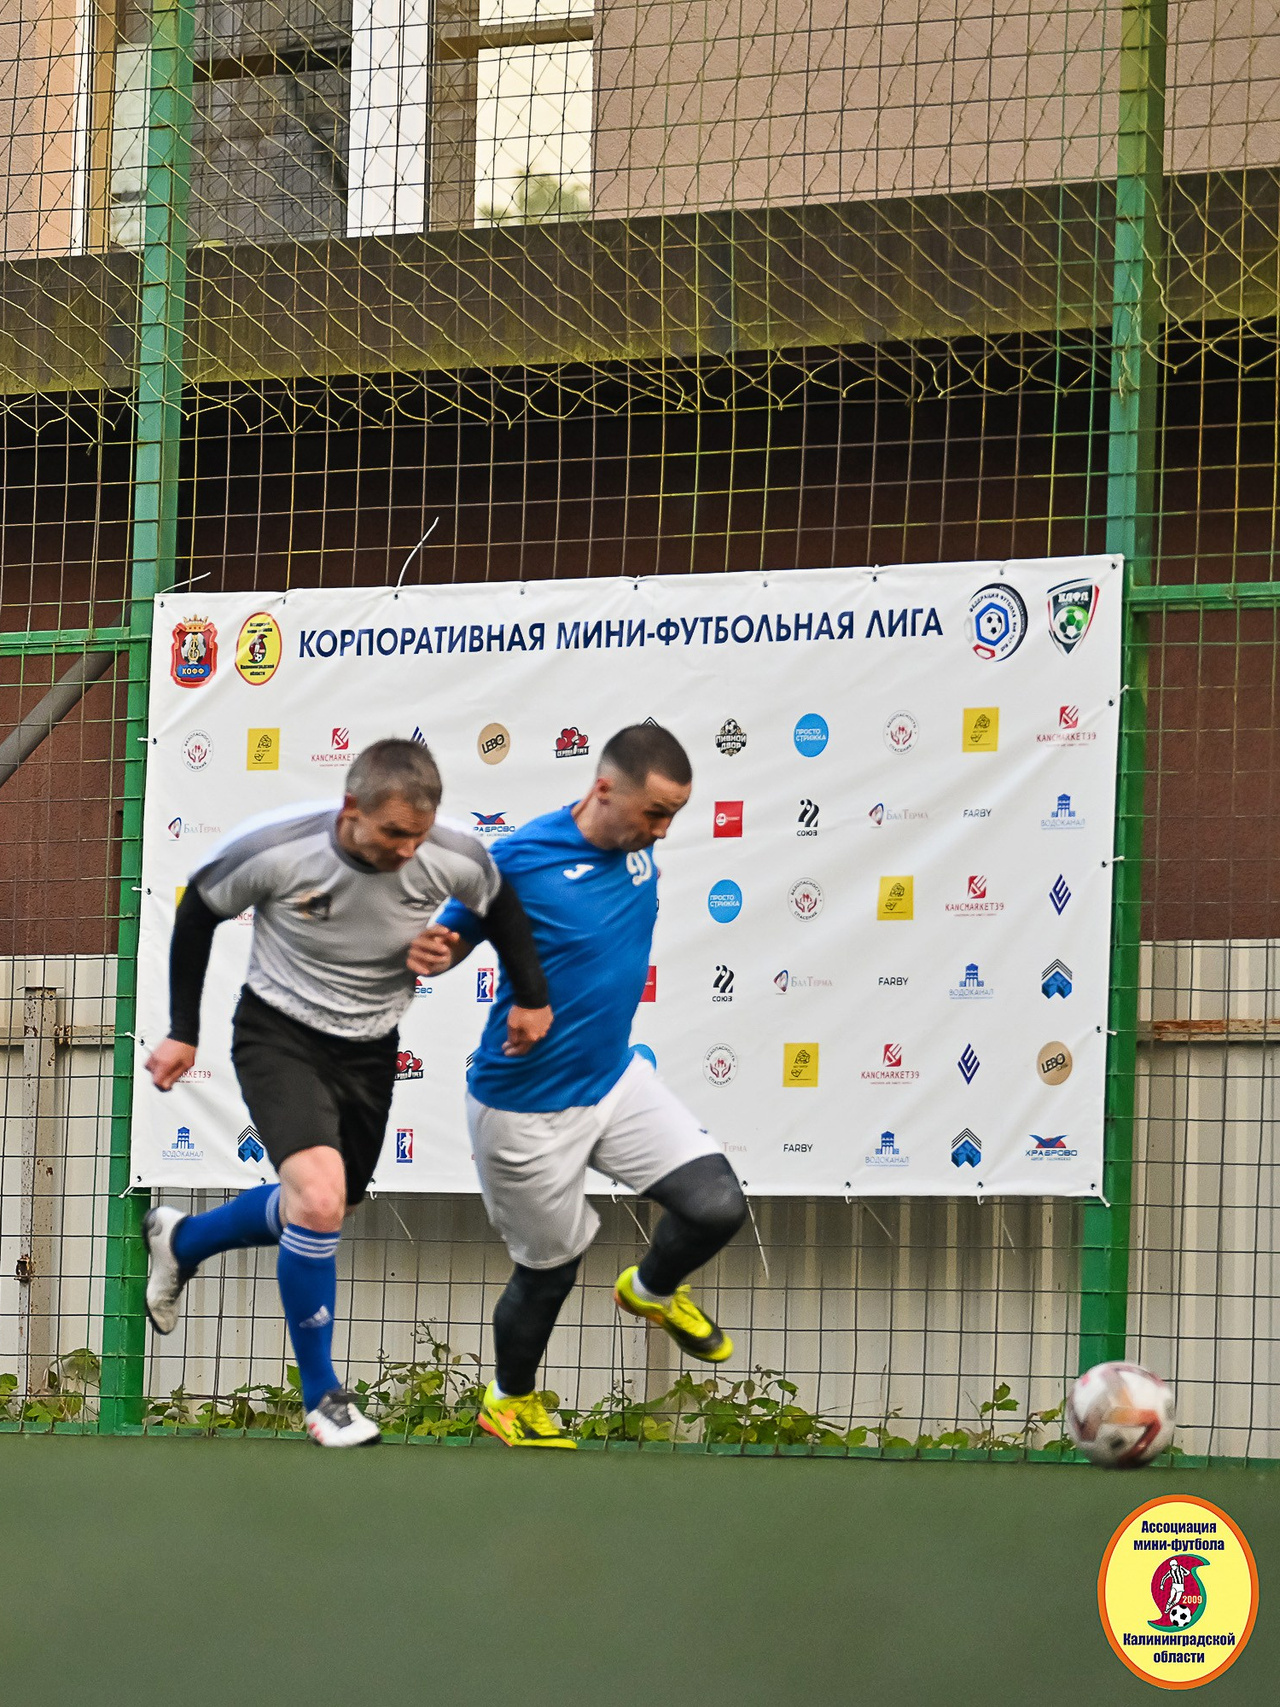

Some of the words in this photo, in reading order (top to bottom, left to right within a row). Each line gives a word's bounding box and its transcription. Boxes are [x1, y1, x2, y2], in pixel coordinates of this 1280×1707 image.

[299, 622, 545, 658] КОРПОРАТИВНАЯ
[557, 612, 854, 649] МИНИ-ФУТБОЛЬНАЯ
[865, 608, 944, 639] ЛИГА
[481, 734, 505, 754] LEBO
[963, 808, 992, 818] FARBY
[1040, 819, 1086, 828] ВОДОКАНАЛ
[473, 825, 516, 833] РАБРОВО
[945, 902, 1005, 912] KANCMARKET39
[878, 977, 909, 986] FARBY
[949, 988, 994, 997] ВОДОКАНАЛ
[1041, 1053, 1066, 1074] LEBO
[860, 1070, 920, 1079] KANCMARKET39
[783, 1143, 814, 1153] FARBY
[161, 1150, 204, 1158] ВОДОКАНАЛ
[1025, 1149, 1078, 1157] ХРАБРОВО
[865, 1156, 910, 1164] ВОДОКАНАЛ
